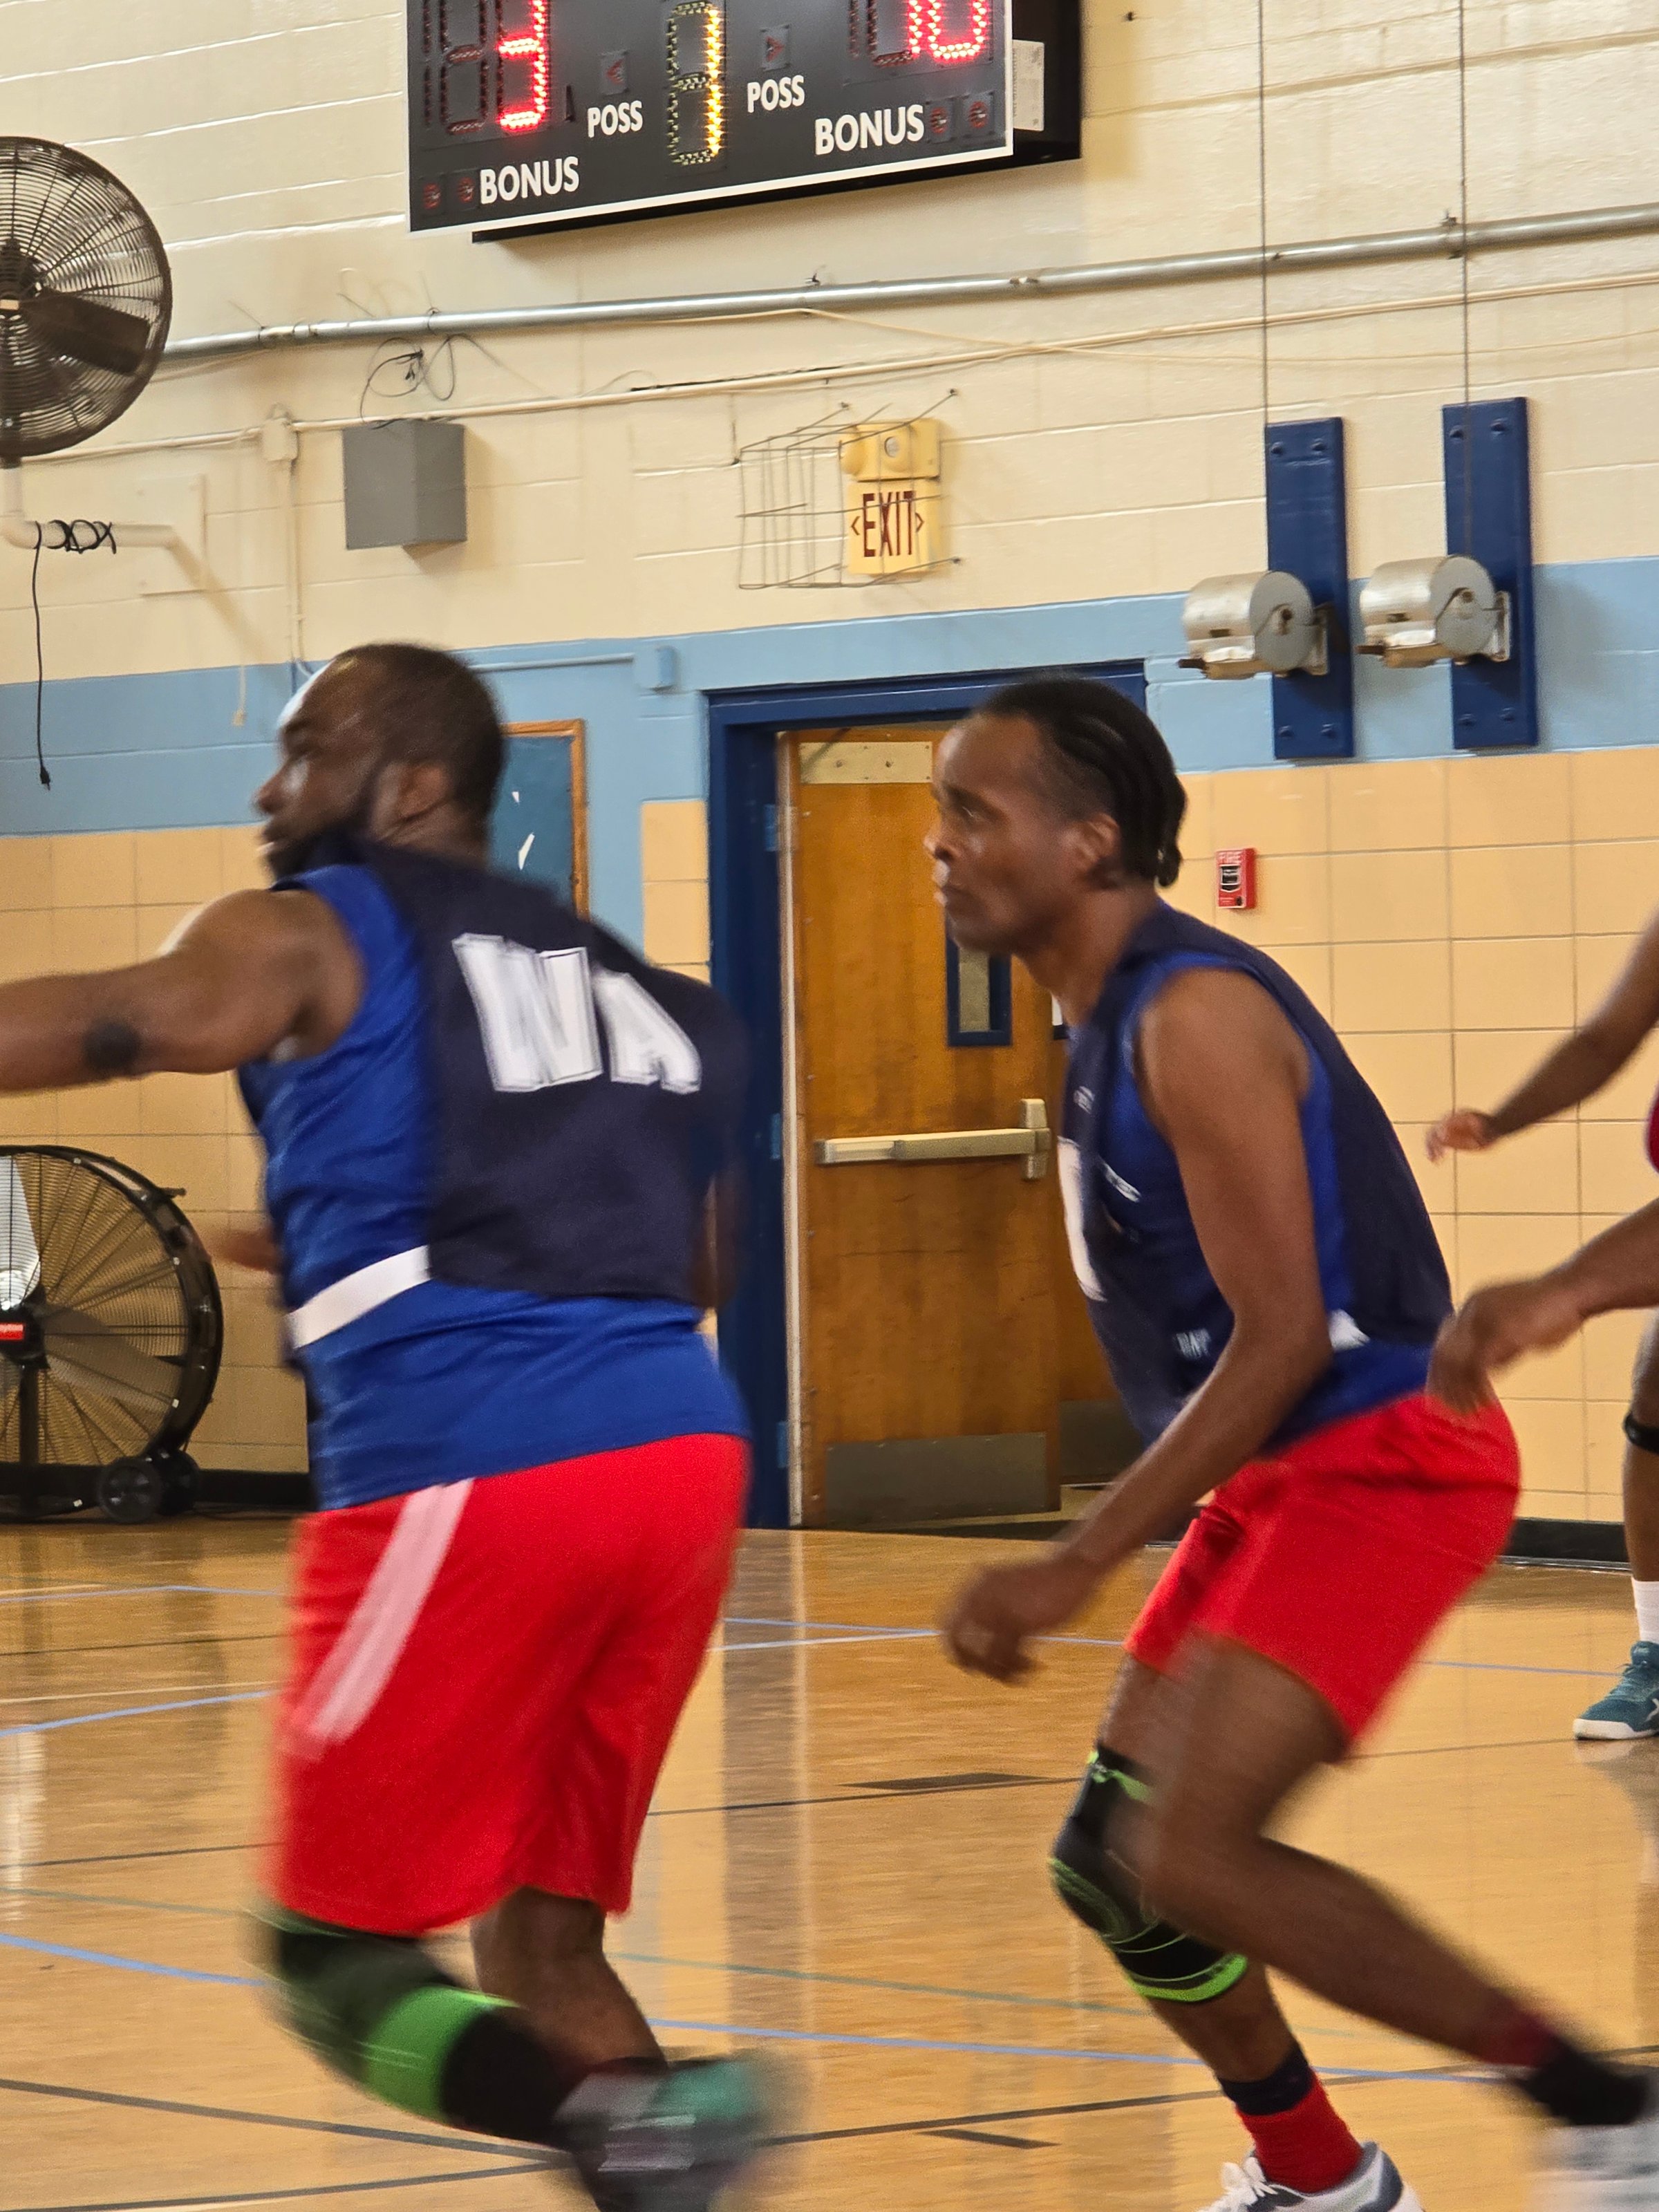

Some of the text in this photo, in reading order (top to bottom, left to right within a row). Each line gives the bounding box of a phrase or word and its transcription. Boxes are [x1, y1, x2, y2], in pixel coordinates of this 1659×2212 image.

[747, 75, 805, 113] POSS
[588, 100, 644, 138] POSS
[814, 104, 925, 156] BONUS
[480, 156, 580, 205] BONUS
[862, 490, 915, 558] EXIT
